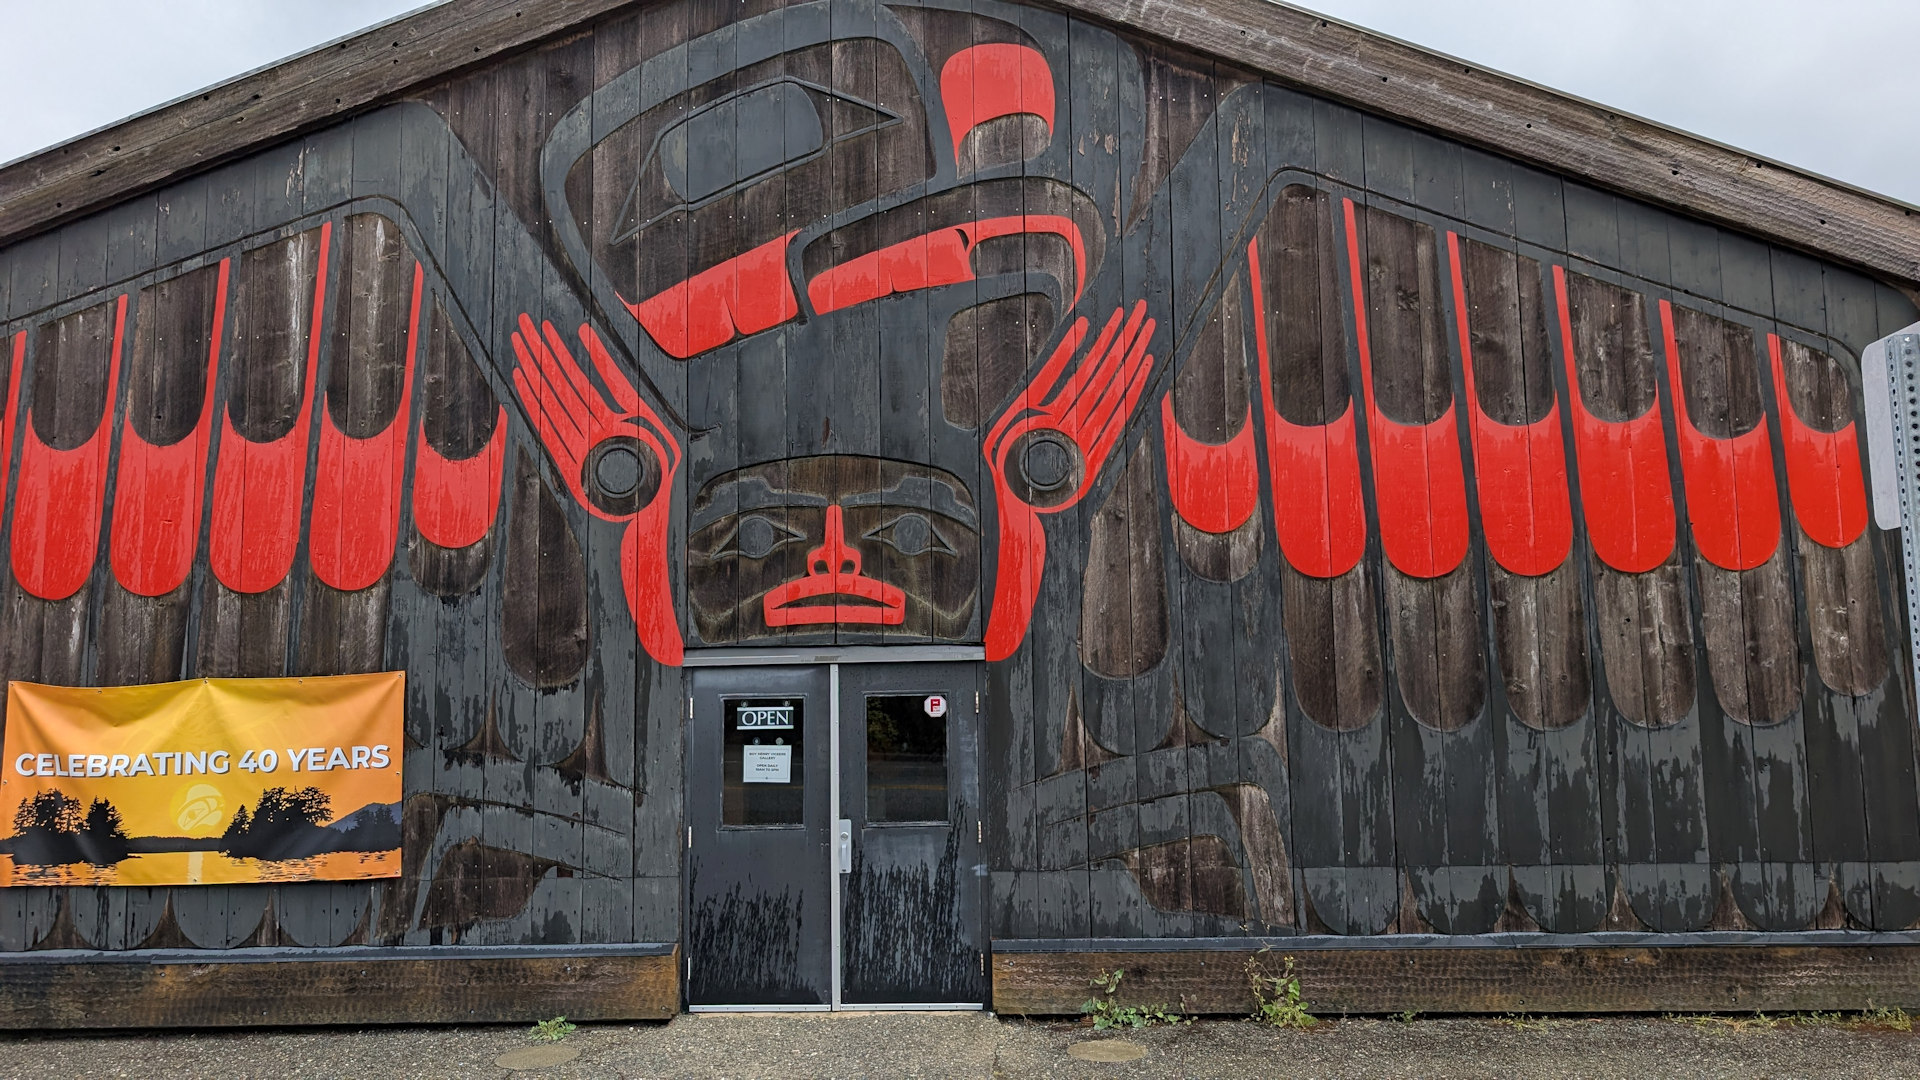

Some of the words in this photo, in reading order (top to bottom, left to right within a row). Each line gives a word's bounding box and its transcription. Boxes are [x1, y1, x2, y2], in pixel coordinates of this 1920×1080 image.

[742, 711, 789, 725] OPEN
[15, 750, 230, 777] CELEBRATING
[238, 749, 278, 772] 40
[287, 745, 391, 771] YEARS
